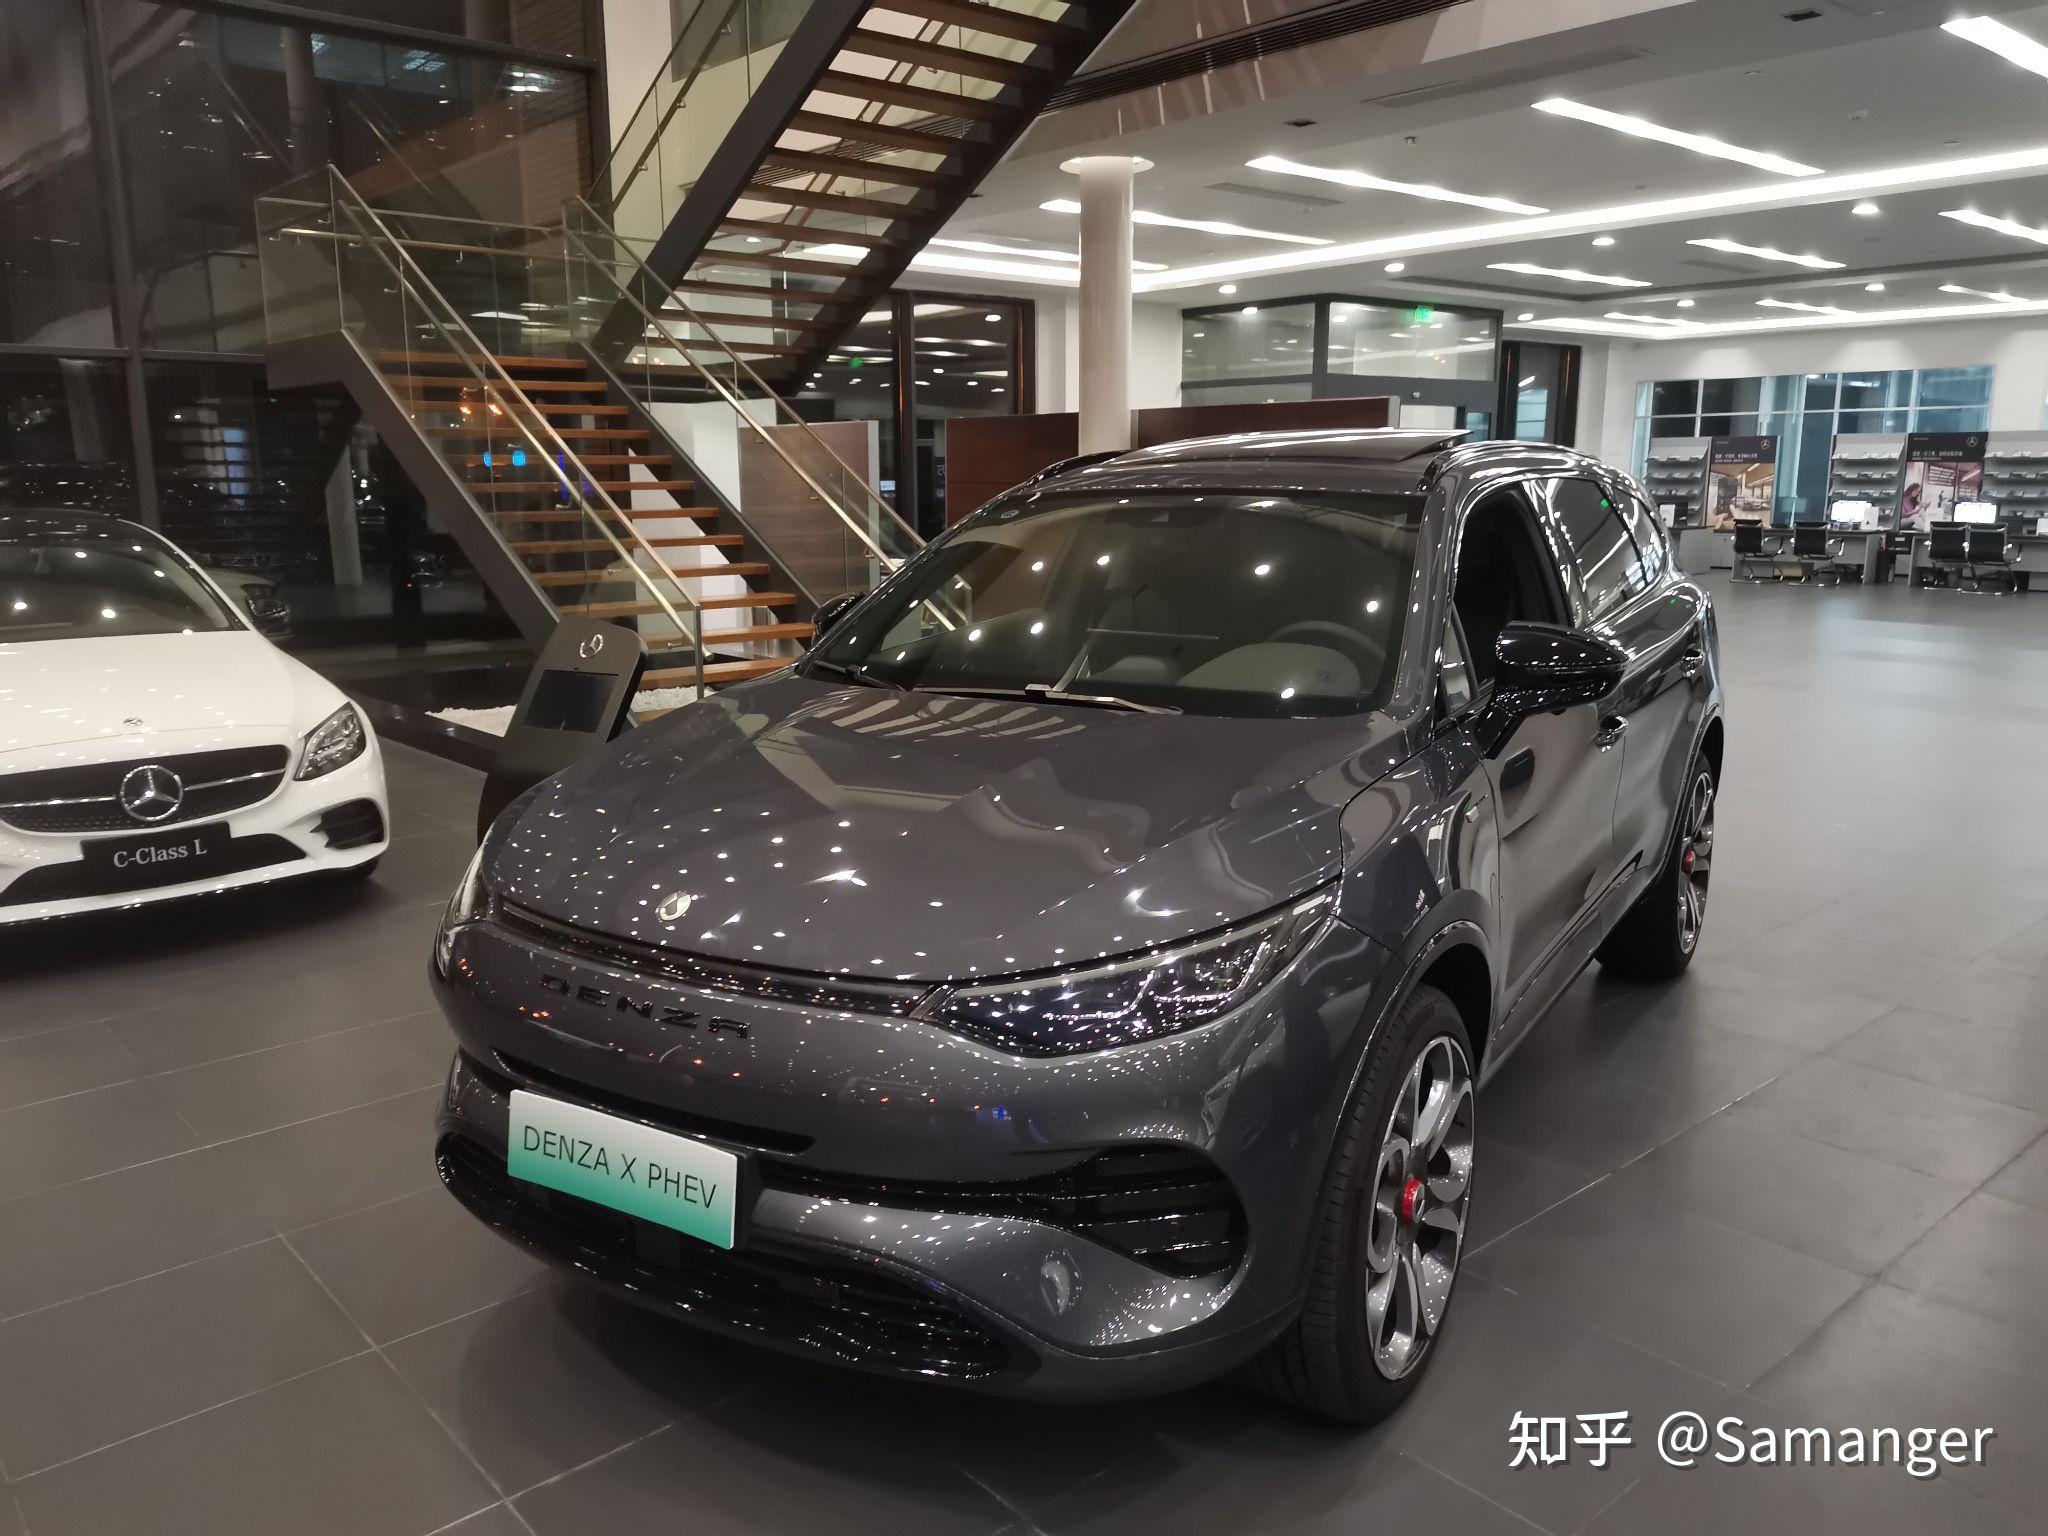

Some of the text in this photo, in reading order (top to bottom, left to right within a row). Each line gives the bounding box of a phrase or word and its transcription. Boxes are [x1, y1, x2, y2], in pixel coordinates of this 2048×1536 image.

[113, 839, 207, 868] C-Class L
[539, 973, 751, 1040] DENZA
[523, 1125, 717, 1209] DENZA X PHEV
